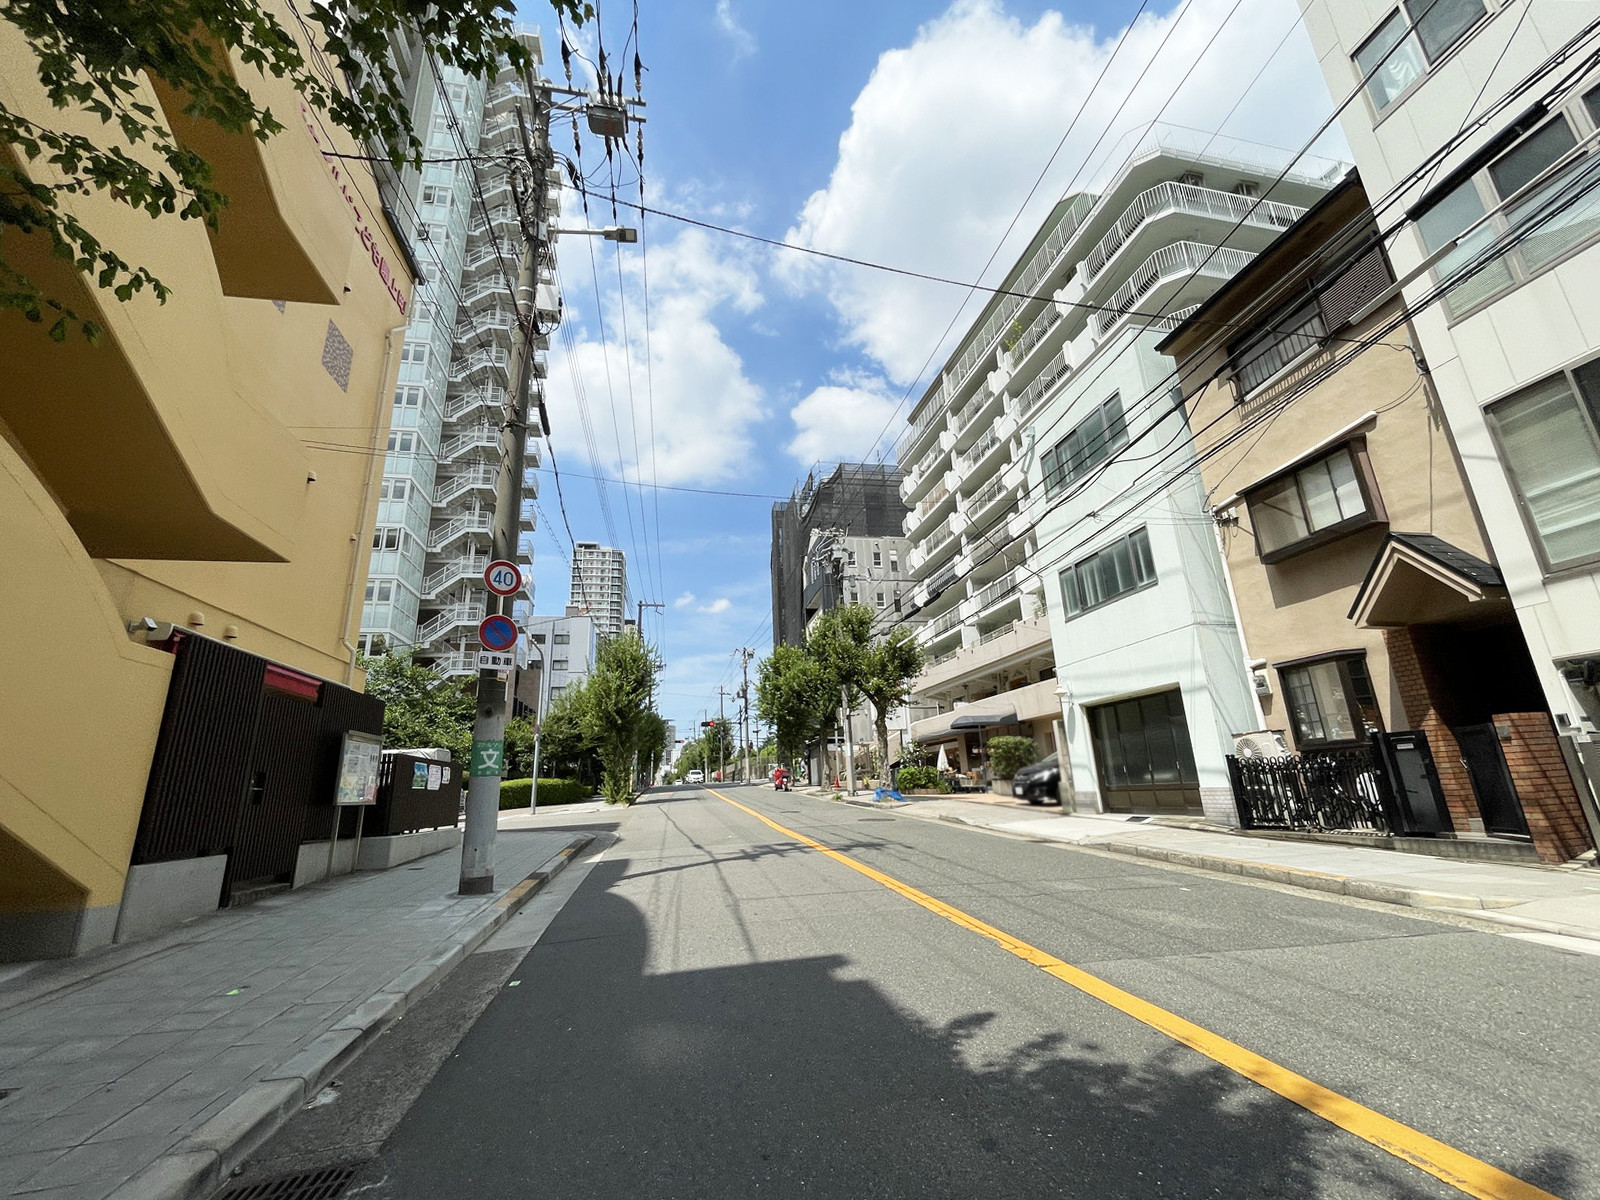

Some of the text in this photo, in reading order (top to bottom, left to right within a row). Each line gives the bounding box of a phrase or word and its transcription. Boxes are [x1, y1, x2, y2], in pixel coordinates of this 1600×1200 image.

[493, 570, 514, 587] 40
[480, 655, 512, 666] 自動車
[478, 748, 500, 769] 文
